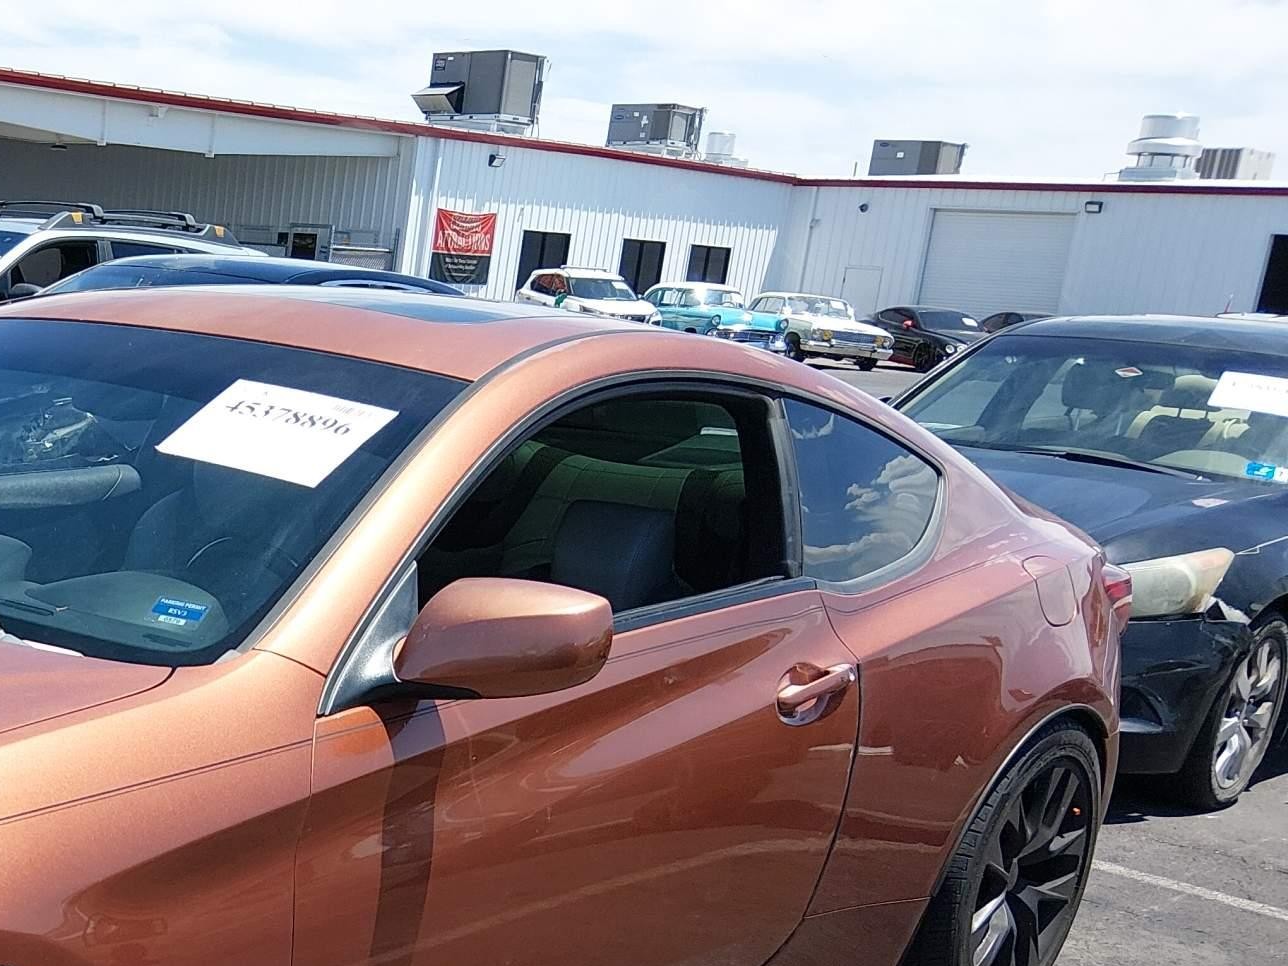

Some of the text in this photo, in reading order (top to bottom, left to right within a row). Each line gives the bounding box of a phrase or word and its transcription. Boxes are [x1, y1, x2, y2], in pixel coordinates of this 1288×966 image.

[224, 399, 352, 436] 45378896
[160, 598, 207, 611] PARKING PERMIT
